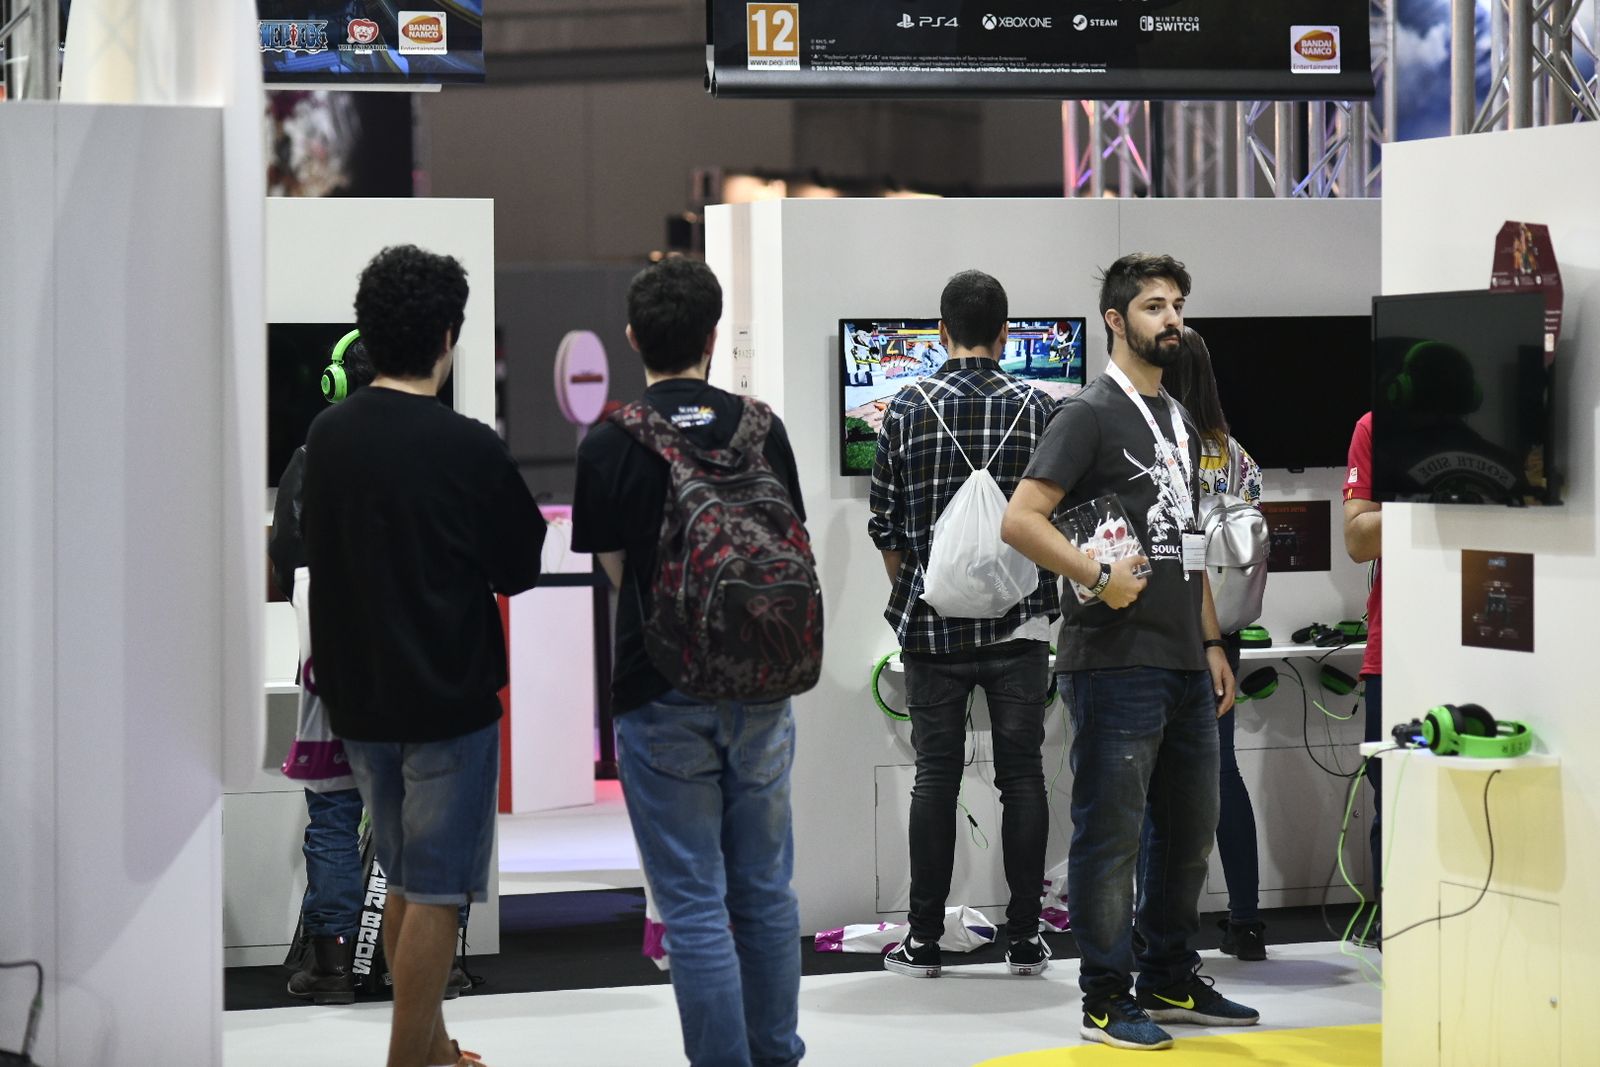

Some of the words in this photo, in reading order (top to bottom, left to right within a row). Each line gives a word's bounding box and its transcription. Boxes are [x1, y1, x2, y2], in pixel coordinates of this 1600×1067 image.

[919, 16, 959, 28] PS4
[998, 16, 1028, 28] XBOX
[1028, 16, 1052, 28] ONE
[1089, 19, 1118, 27] STEAM
[1155, 22, 1200, 32] SWITCH
[752, 9, 794, 51] 12
[1301, 47, 1332, 55] NAMCO
[352, 910, 382, 975] BROS
